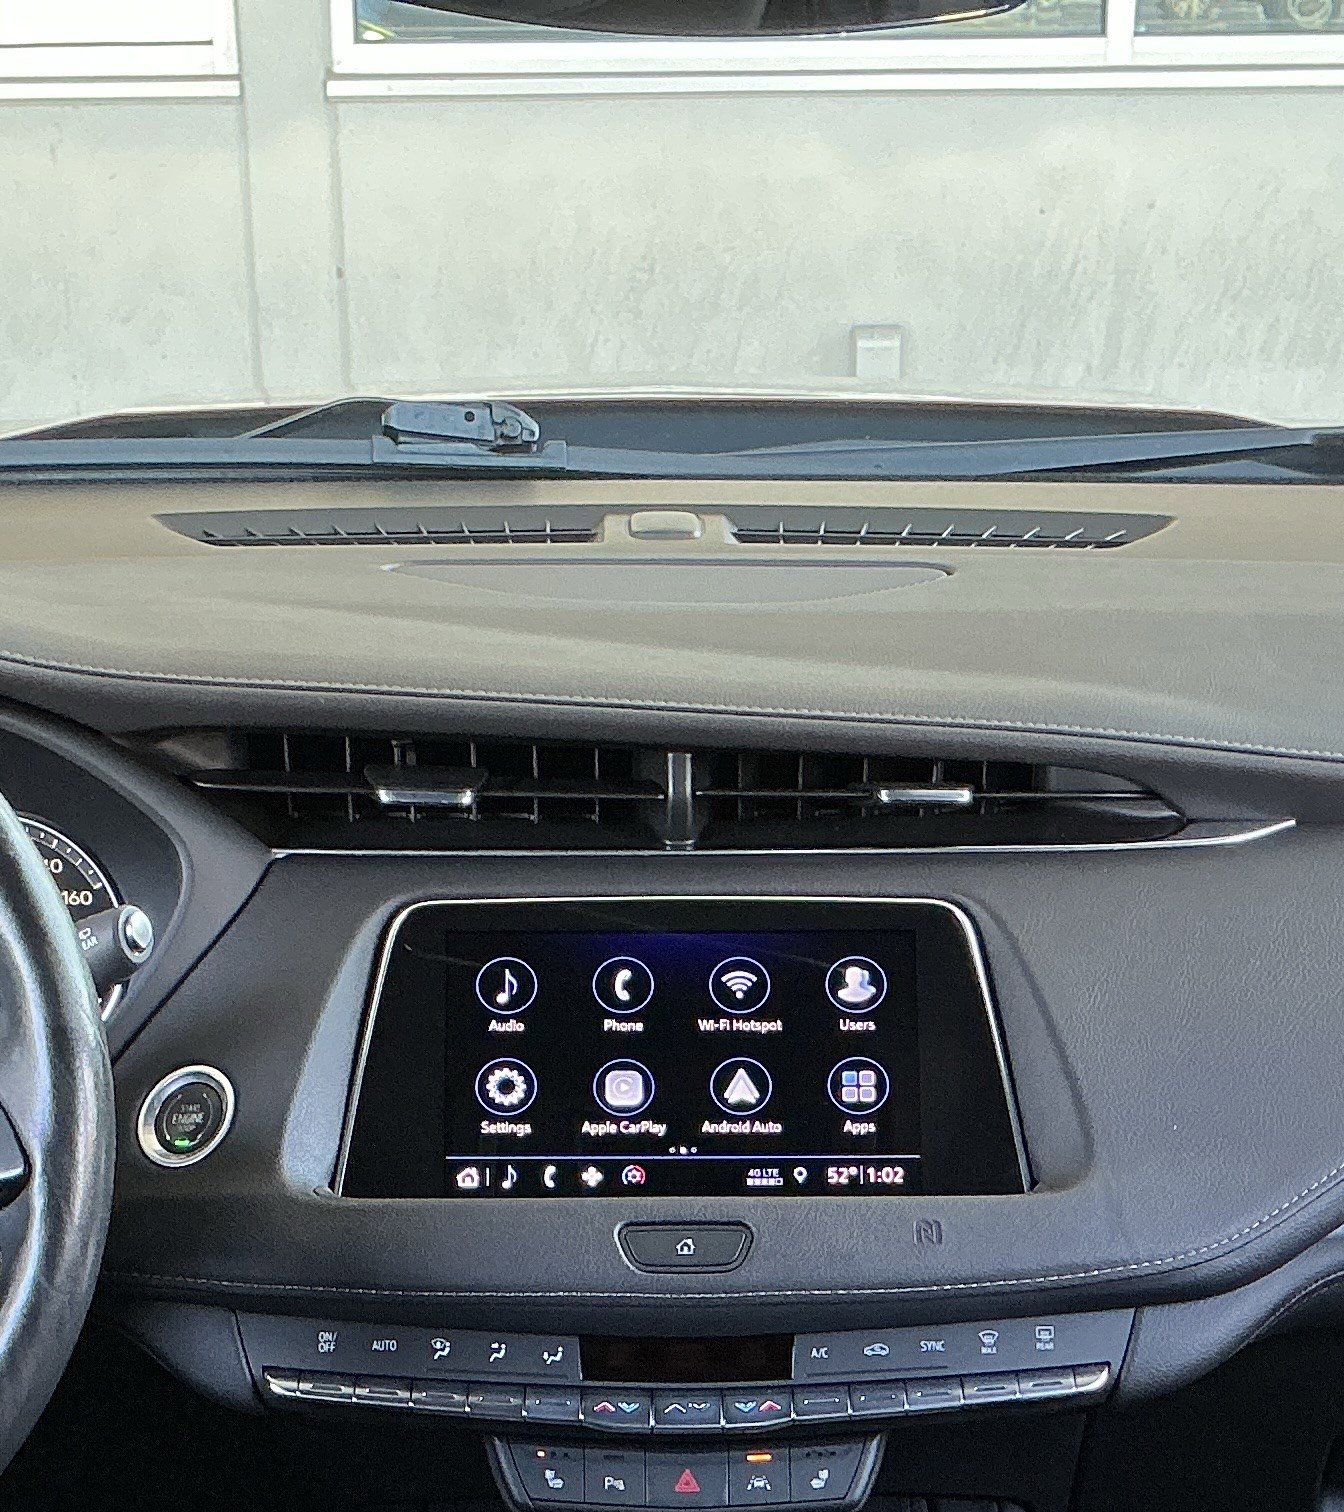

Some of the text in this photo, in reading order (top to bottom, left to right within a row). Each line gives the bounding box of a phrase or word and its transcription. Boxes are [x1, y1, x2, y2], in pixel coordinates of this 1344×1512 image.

[60, 890, 93, 906] 160
[488, 1018, 525, 1032] Audio
[603, 1018, 644, 1032] Phone
[697, 1018, 783, 1034] Wi-Fi Hotspot
[839, 1018, 876, 1032] Users
[480, 1121, 532, 1136] Settings
[581, 1120, 667, 1136] Apple CarPlay
[701, 1120, 782, 1133] Android Auto
[843, 1120, 876, 1135] Apps
[763, 1168, 779, 1177] LTE
[866, 1166, 905, 1183] 1:02
[318, 1331, 338, 1342] ON/
[318, 1341, 336, 1353] OFF
[372, 1339, 398, 1351] AUTO
[920, 1340, 946, 1352] SYNC
[810, 1347, 829, 1359] A/C
